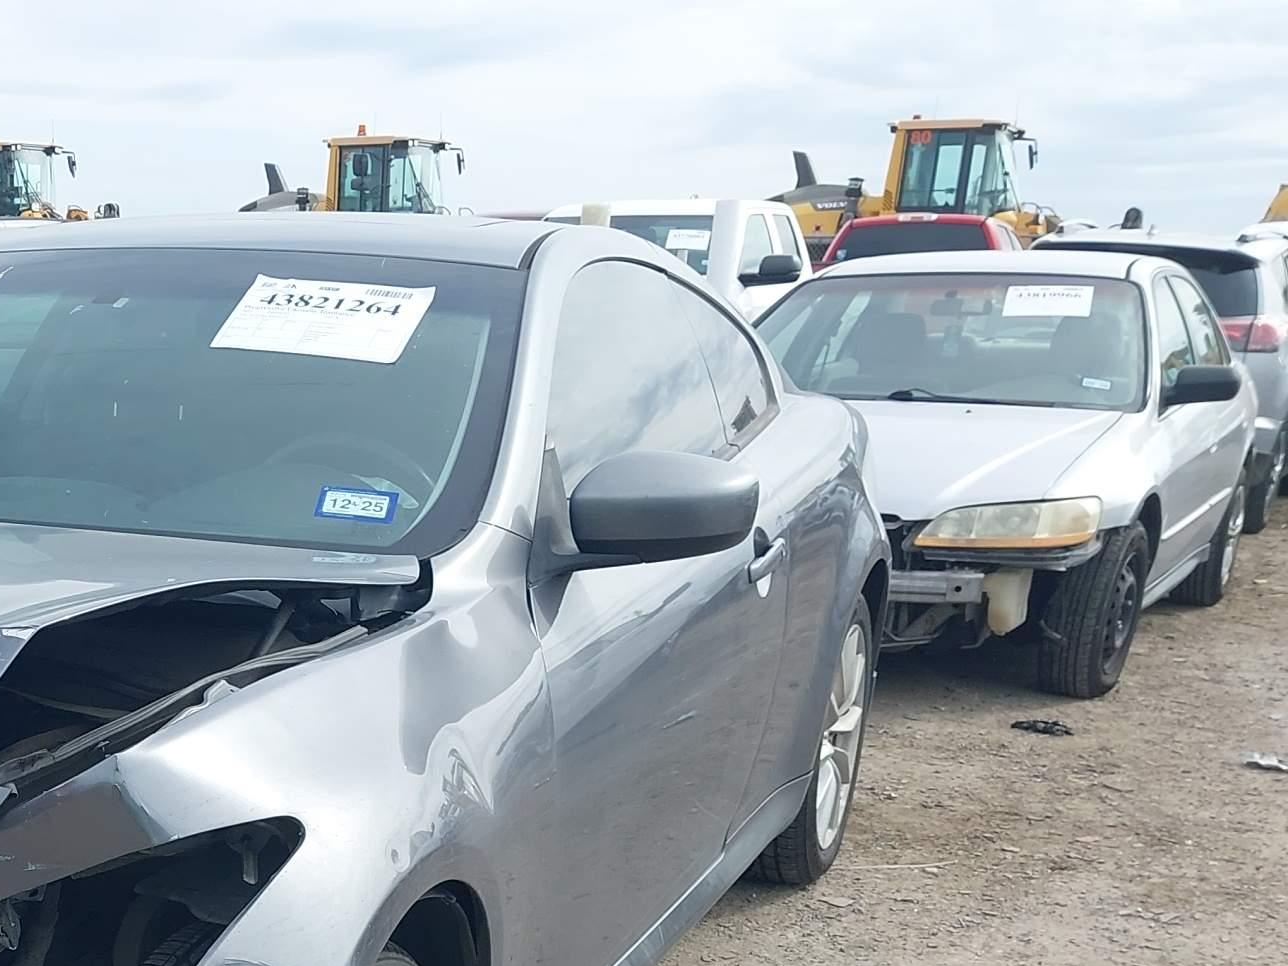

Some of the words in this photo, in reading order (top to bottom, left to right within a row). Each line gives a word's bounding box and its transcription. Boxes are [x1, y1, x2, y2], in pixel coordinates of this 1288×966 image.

[910, 130, 932, 144] 80
[816, 201, 848, 209] VOLV
[259, 293, 402, 316] 43821264
[329, 498, 352, 510] 12
[360, 500, 385, 513] 25
